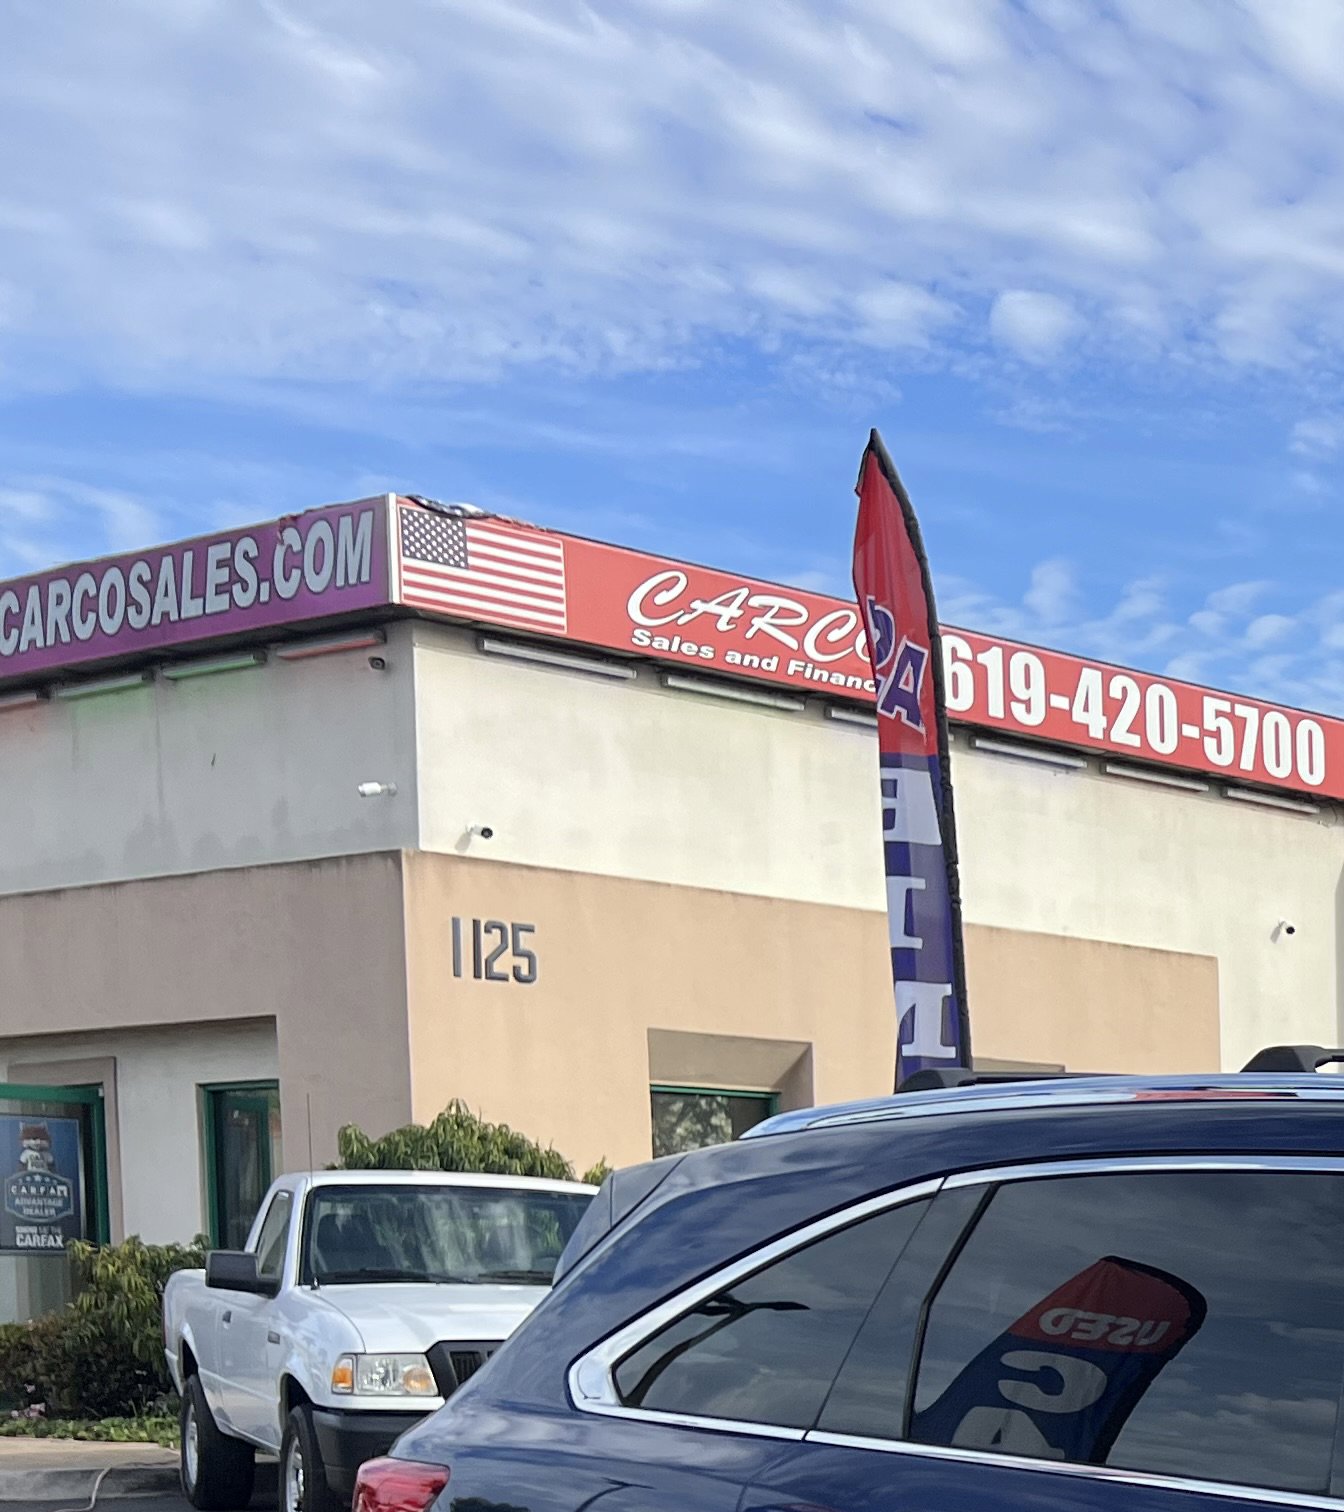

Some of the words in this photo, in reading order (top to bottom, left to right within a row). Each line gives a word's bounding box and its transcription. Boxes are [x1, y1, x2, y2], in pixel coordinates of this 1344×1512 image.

[0, 510, 374, 656] CARCOSALES.COM
[631, 628, 715, 660] Sales
[724, 649, 779, 673] and
[940, 633, 1326, 787] 619-420-5700
[451, 916, 537, 984] 1125
[16, 1234, 64, 1248] CARFAX
